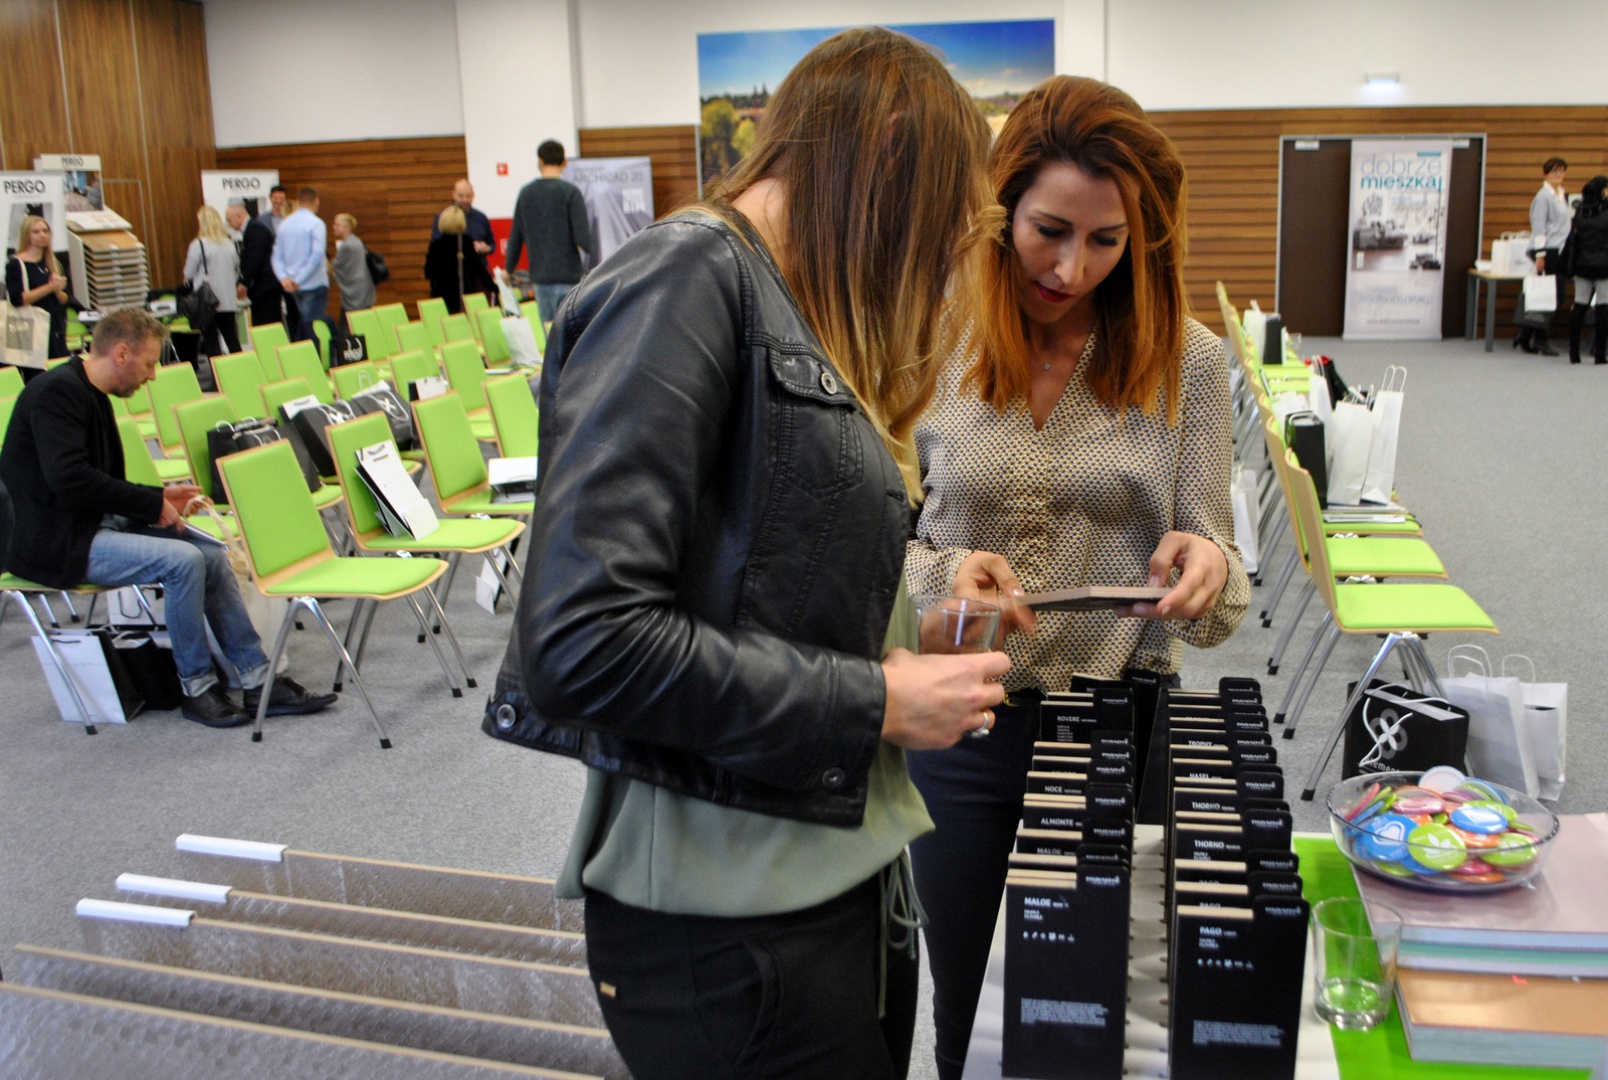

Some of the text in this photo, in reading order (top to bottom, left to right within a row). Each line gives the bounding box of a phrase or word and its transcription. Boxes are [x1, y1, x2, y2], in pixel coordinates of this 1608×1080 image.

[1360, 153, 1441, 175] dobrze
[4, 180, 45, 194] PERGO
[222, 176, 260, 190] PERGO
[1360, 174, 1442, 192] mieszkaj
[1044, 785, 1063, 793] NOCE
[1040, 817, 1074, 827] ALMONTE
[1193, 839, 1225, 849] THORNO
[1024, 896, 1051, 908] MALOE
[1199, 926, 1222, 936] PAGO
